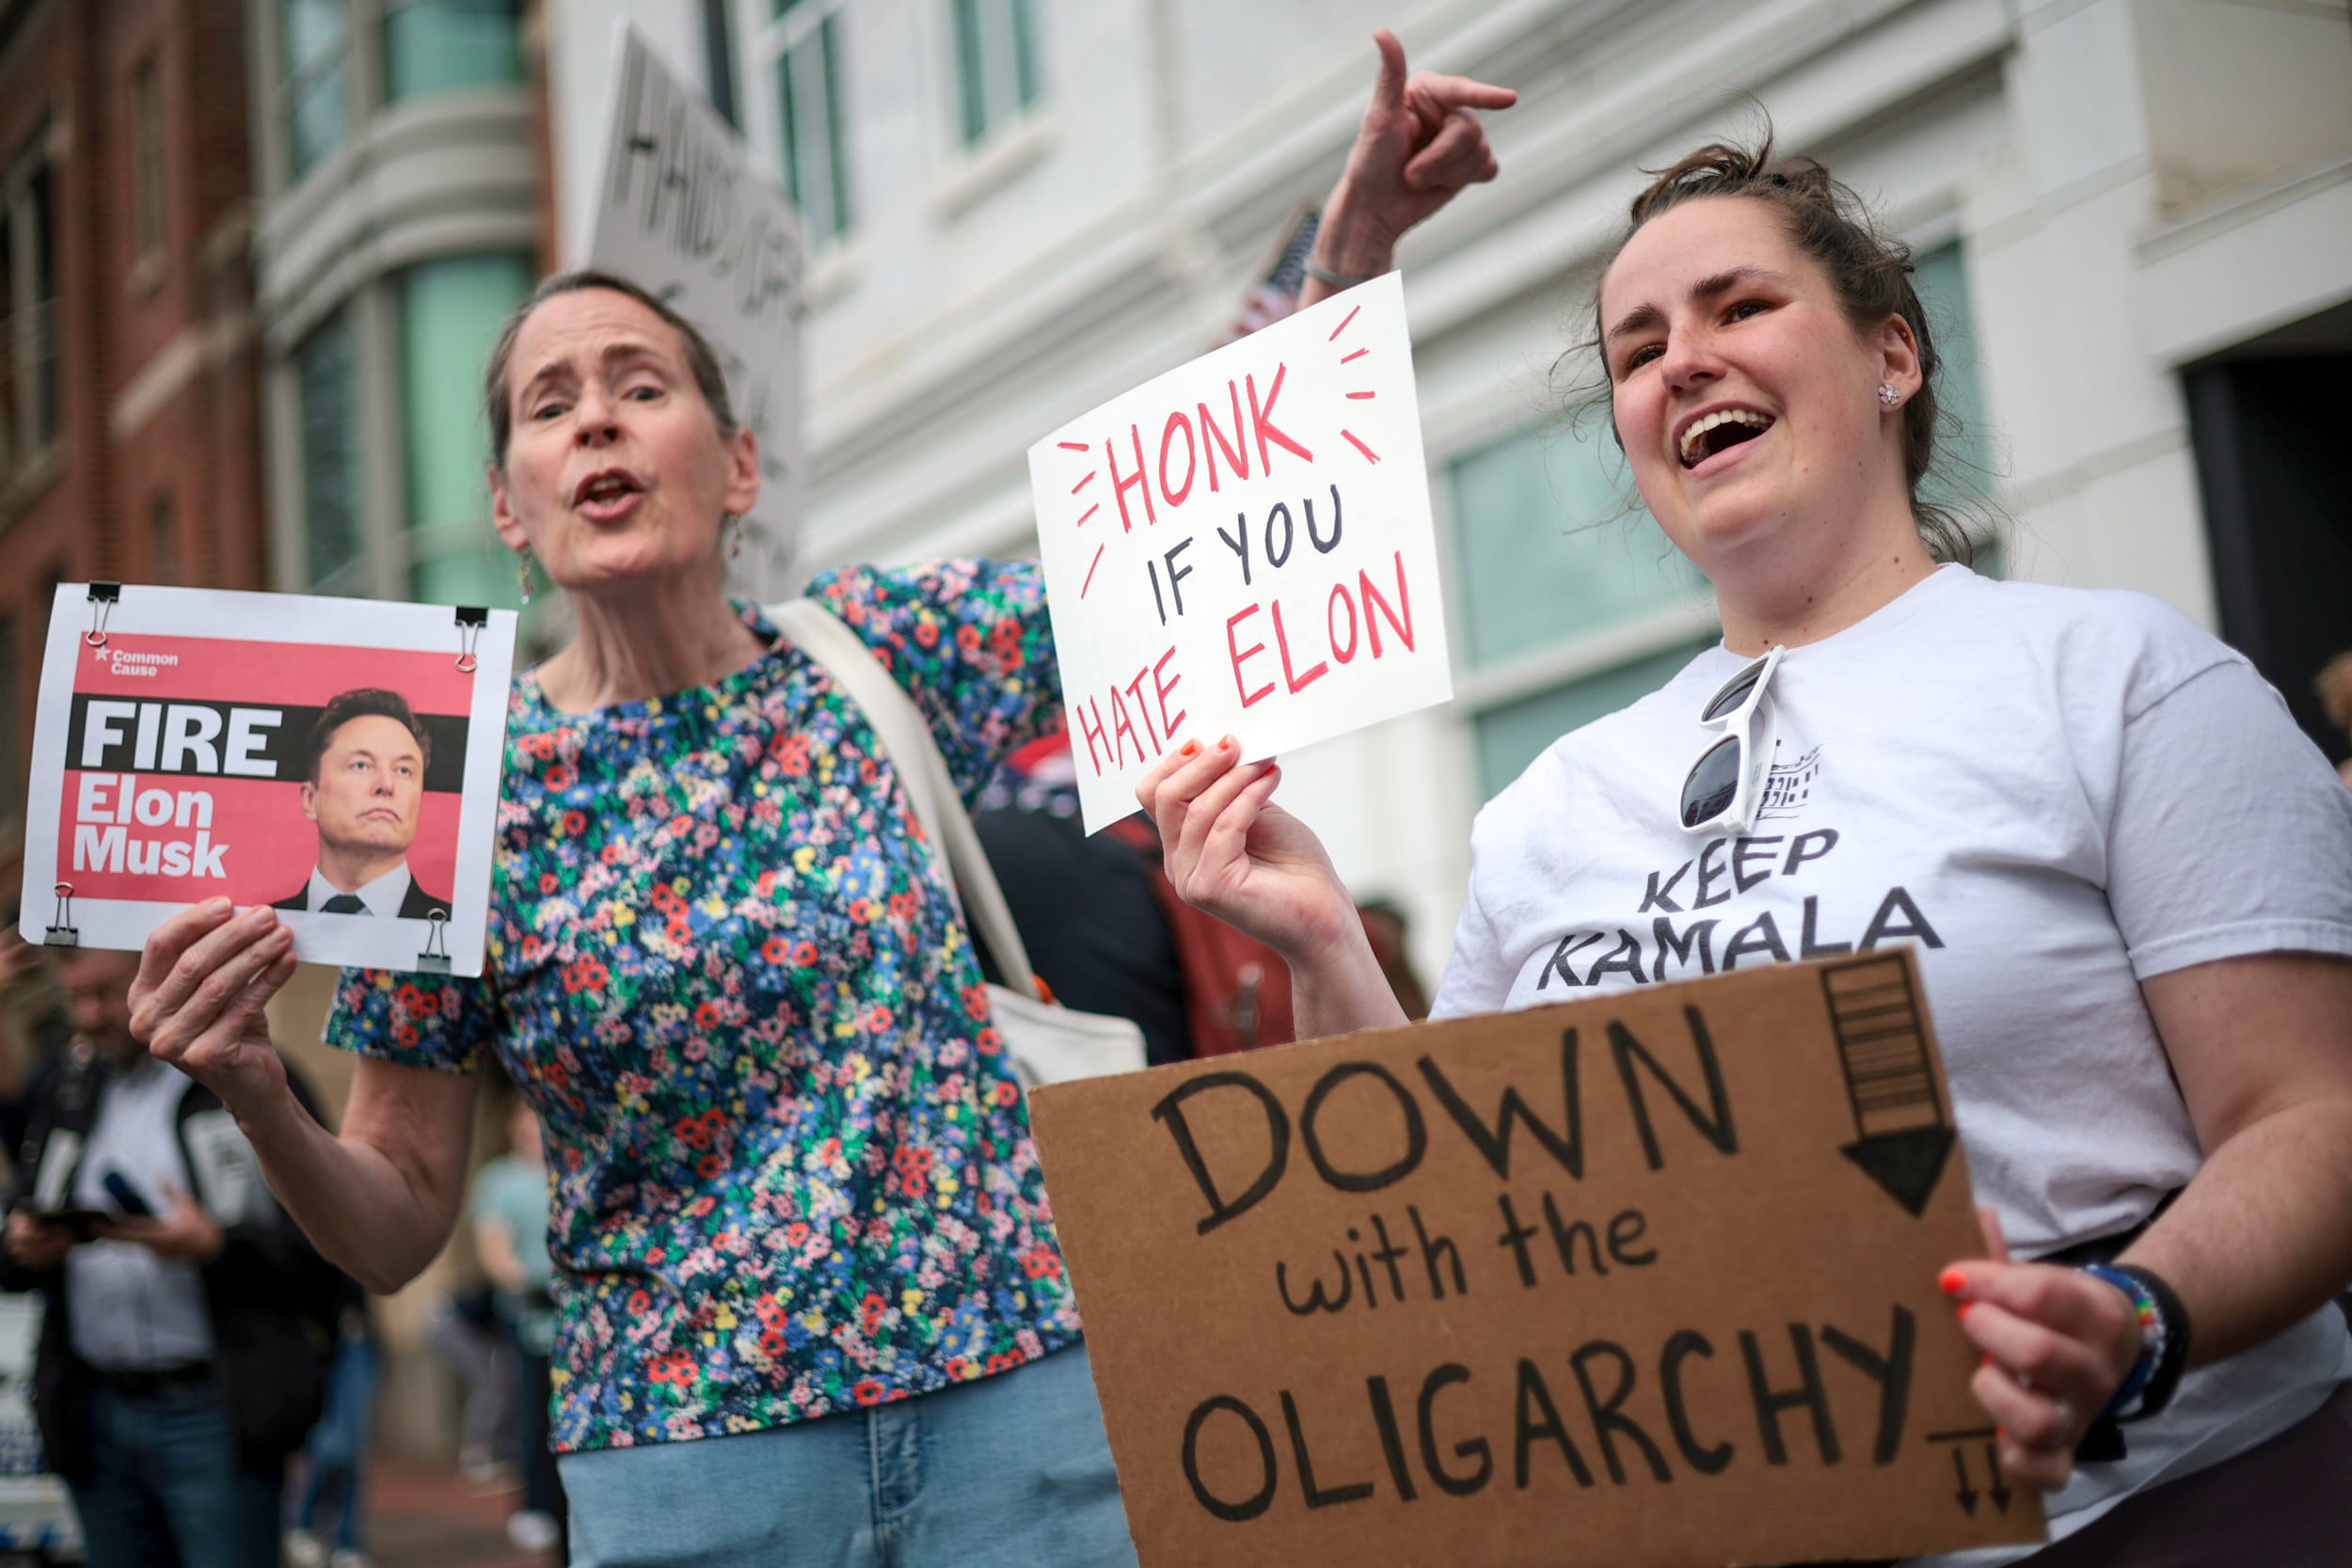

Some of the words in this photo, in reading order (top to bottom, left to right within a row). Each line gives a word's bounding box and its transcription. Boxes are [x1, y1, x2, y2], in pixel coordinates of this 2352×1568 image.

[1105, 361, 1313, 533] HONK
[1147, 536, 1194, 626] IF
[1216, 483, 1343, 586] YOU
[110, 662, 158, 677] Cause
[112, 649, 179, 666] Common
[1076, 645, 1187, 777] HATE
[1227, 550, 1415, 708] ELON
[81, 700, 283, 778] FIRE
[72, 824, 230, 879] Musk
[76, 772, 215, 829] Elon
[1637, 828, 1839, 913] KEEP
[1536, 885, 1946, 990] KAMALA
[1151, 1003, 1739, 1236] DOWN
[1276, 1204, 1468, 1315] with
[1497, 1190, 1659, 1289] the
[1181, 1304, 1916, 1522] OLIGARCHY
